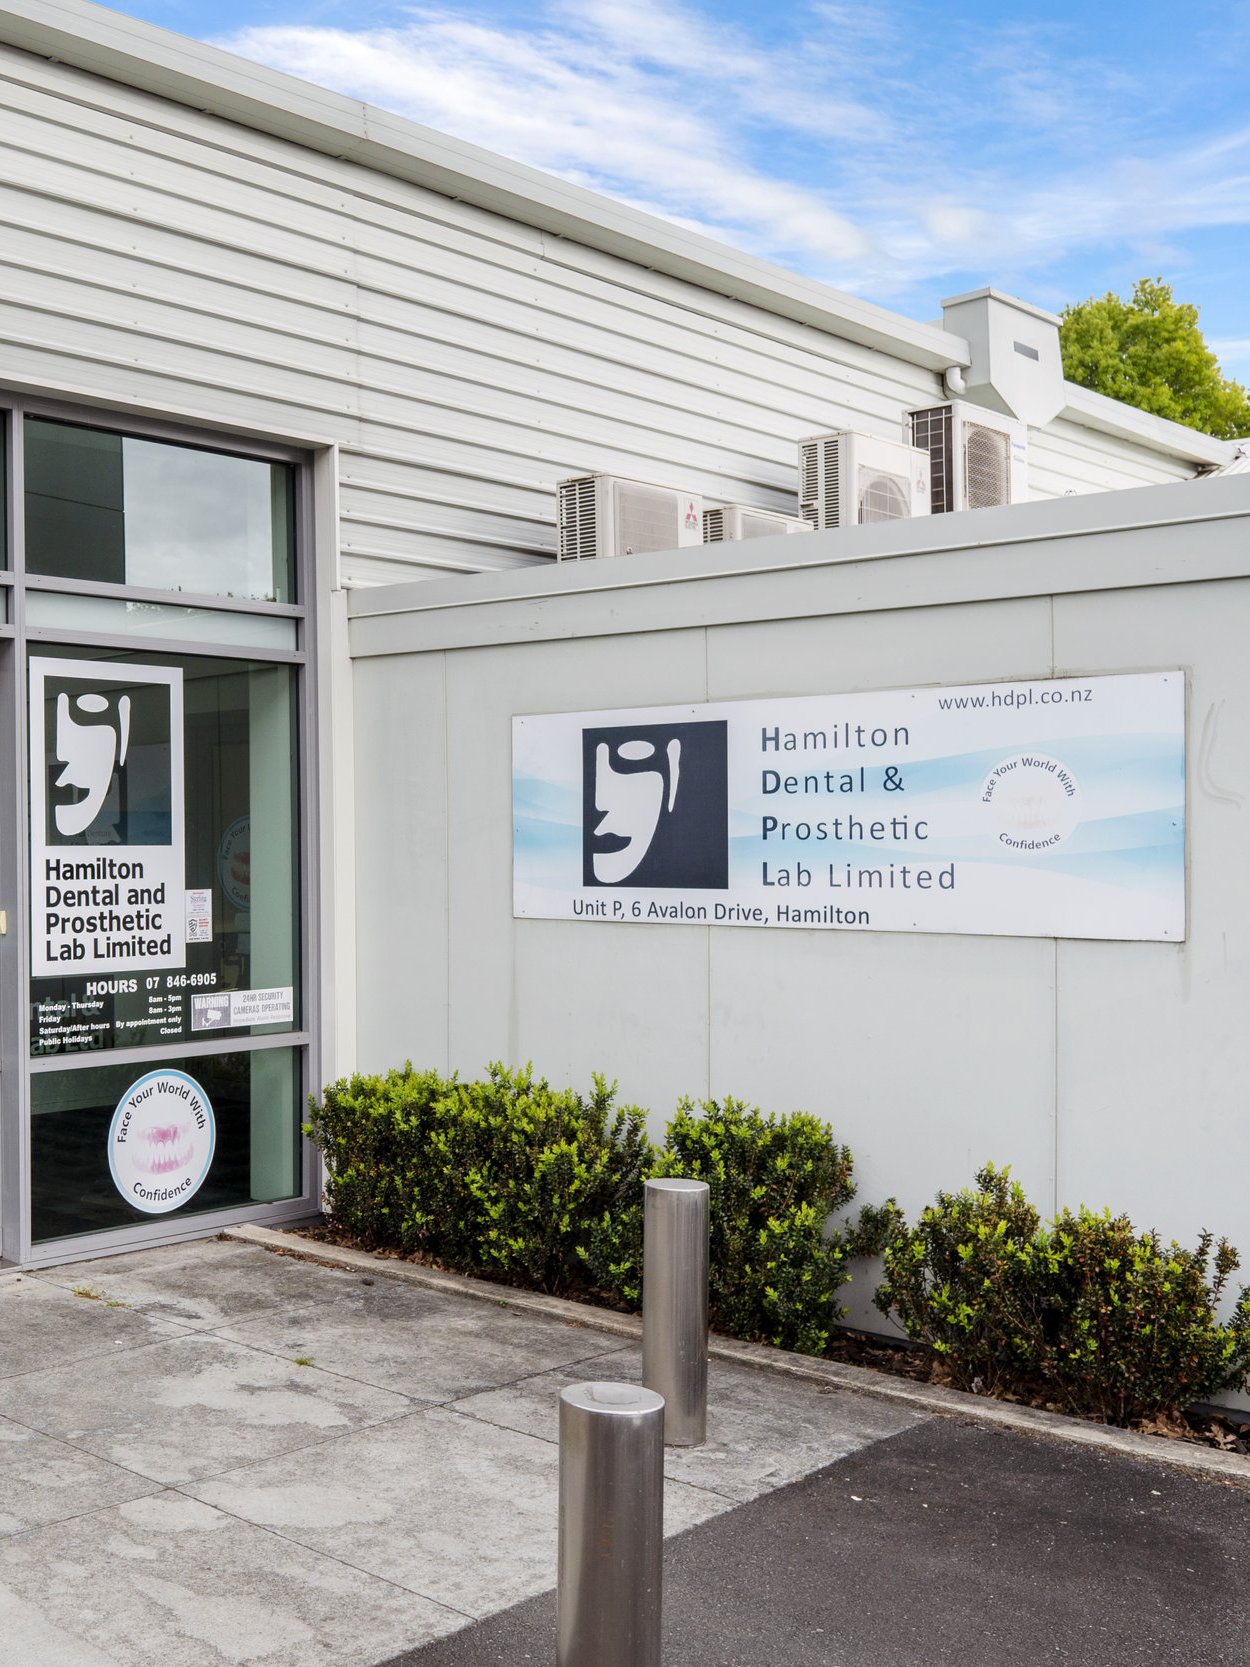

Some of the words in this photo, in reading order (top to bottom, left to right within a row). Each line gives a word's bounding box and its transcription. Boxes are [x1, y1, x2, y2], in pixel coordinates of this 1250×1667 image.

[938, 688, 1093, 710] www.hdpl.co.nz
[761, 722, 909, 752] Hamilton
[762, 766, 865, 794] Dental
[883, 765, 905, 792] &
[982, 778, 997, 803] Face
[992, 760, 1018, 778] Your
[1021, 757, 1057, 773] World
[1056, 769, 1076, 798] With
[762, 814, 928, 840] Prosthetic
[998, 832, 1061, 850] Confidence
[45, 857, 144, 881] Hamilton
[762, 861, 812, 887] Lab
[829, 862, 955, 890] Limited
[46, 883, 120, 908] Dental
[127, 882, 165, 906] and
[46, 908, 163, 935] Prosthetic
[572, 899, 607, 917] Unit
[612, 900, 625, 920] P,
[631, 901, 642, 917] 6
[647, 900, 707, 919] Avalon
[714, 902, 770, 924] Drive,
[776, 904, 870, 925] Hamilton
[46, 938, 86, 961] Lab
[93, 933, 172, 959] Limited
[86, 978, 138, 996] HOURS
[146, 976, 160, 990] 07
[166, 972, 217, 988] 846-6905
[39, 1003, 67, 1012] Monday
[71, 1000, 104, 1010] Thursday
[148, 995, 163, 1003] 8am
[167, 994, 182, 1003] 5pm
[193, 995, 229, 1010] WARNING
[233, 1004, 260, 1015] CAMERAS
[261, 1002, 291, 1013] OPERATING
[242, 994, 257, 1003] 24HR
[257, 991, 284, 1002] SECURITY
[38, 1015, 61, 1024] Friday
[148, 1006, 163, 1014] 8am
[90, 1022, 111, 1030] hours
[115, 1020, 126, 1029] By
[126, 1016, 167, 1028] appointment
[167, 1015, 182, 1024] only
[38, 1037, 62, 1047] Public
[62, 1034, 93, 1044] Holidays
[159, 1025, 182, 1035] Closed
[117, 1111, 132, 1143] Face
[128, 1086, 154, 1109] Your
[157, 1081, 191, 1100] World
[189, 1095, 206, 1130] With
[133, 1177, 192, 1201] Confidence
